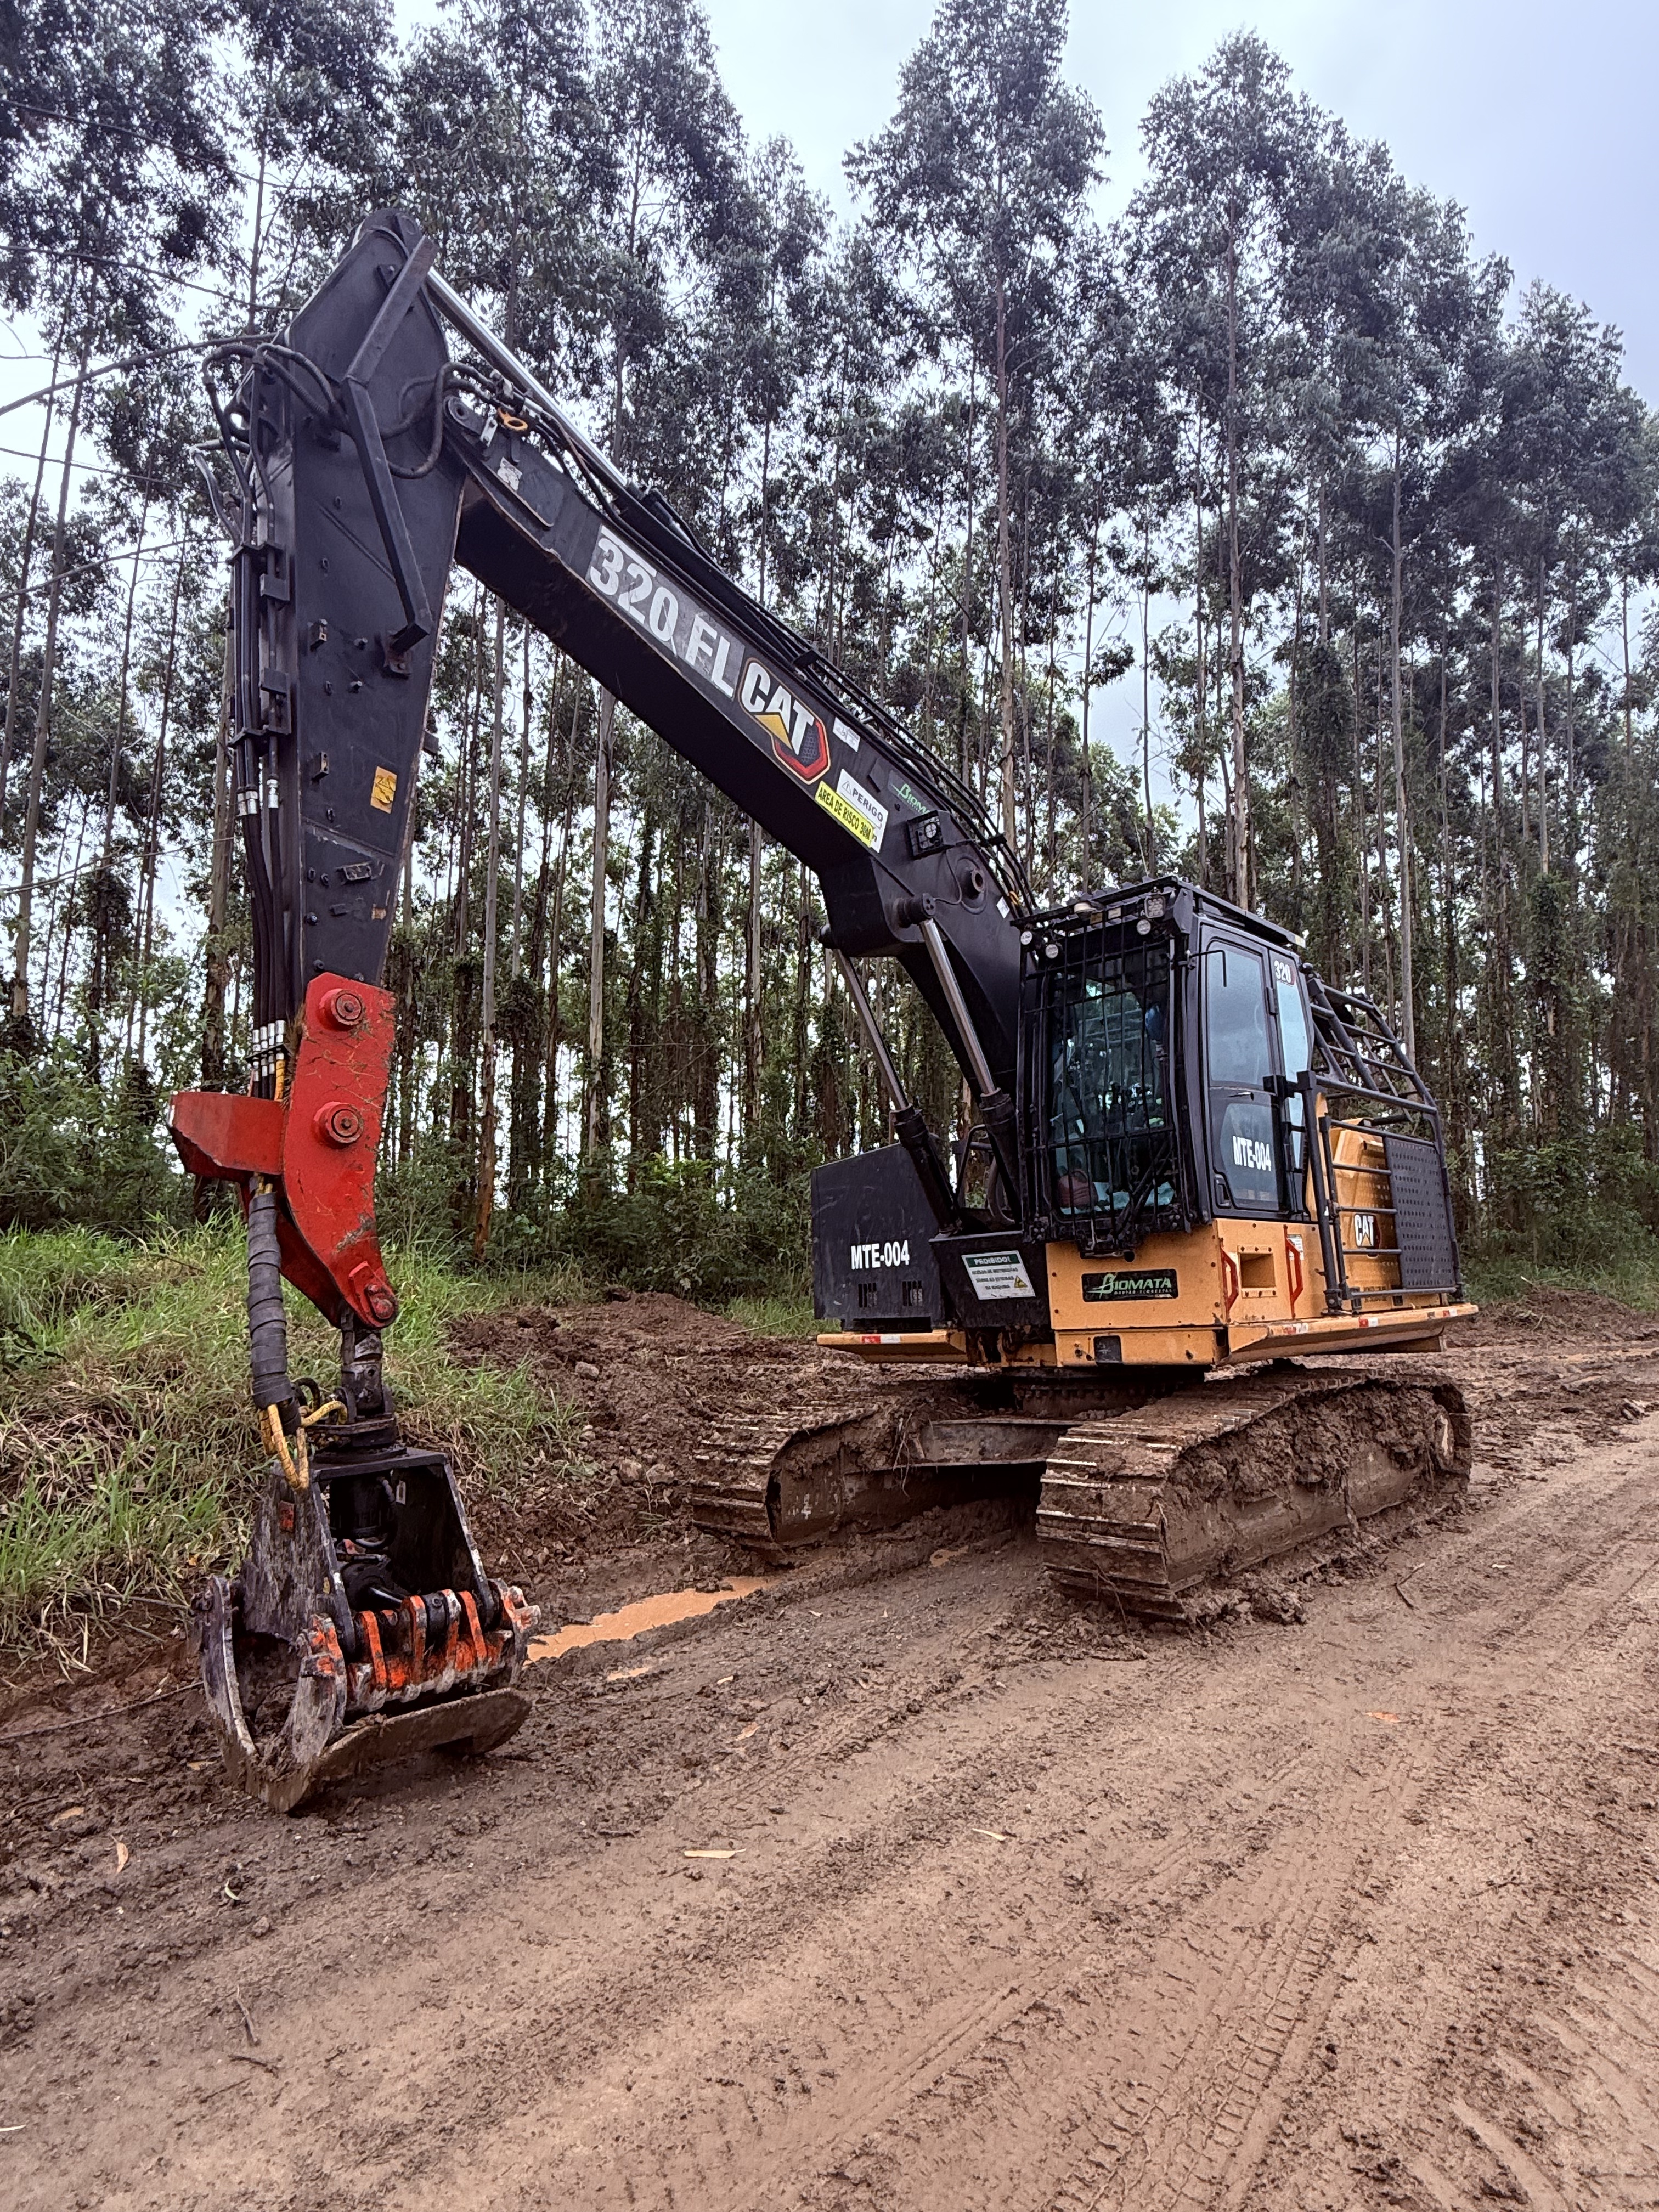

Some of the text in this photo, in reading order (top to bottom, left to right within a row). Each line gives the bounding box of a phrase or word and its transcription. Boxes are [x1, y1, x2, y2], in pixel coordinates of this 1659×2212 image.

[590, 538, 736, 698] 320 FL
[741, 662, 815, 755] CAT
[852, 788, 883, 822] PERIGO
[892, 783, 930, 814] BIOM
[834, 799, 843, 816] DE
[842, 806, 860, 831] RISCO
[1274, 960, 1291, 983] 320
[1232, 1136, 1272, 1171] MTE-004
[1355, 1214, 1374, 1247] CAT
[850, 1239, 910, 1270] MTE-004
[1087, 1273, 1172, 1297] BIOMATA
